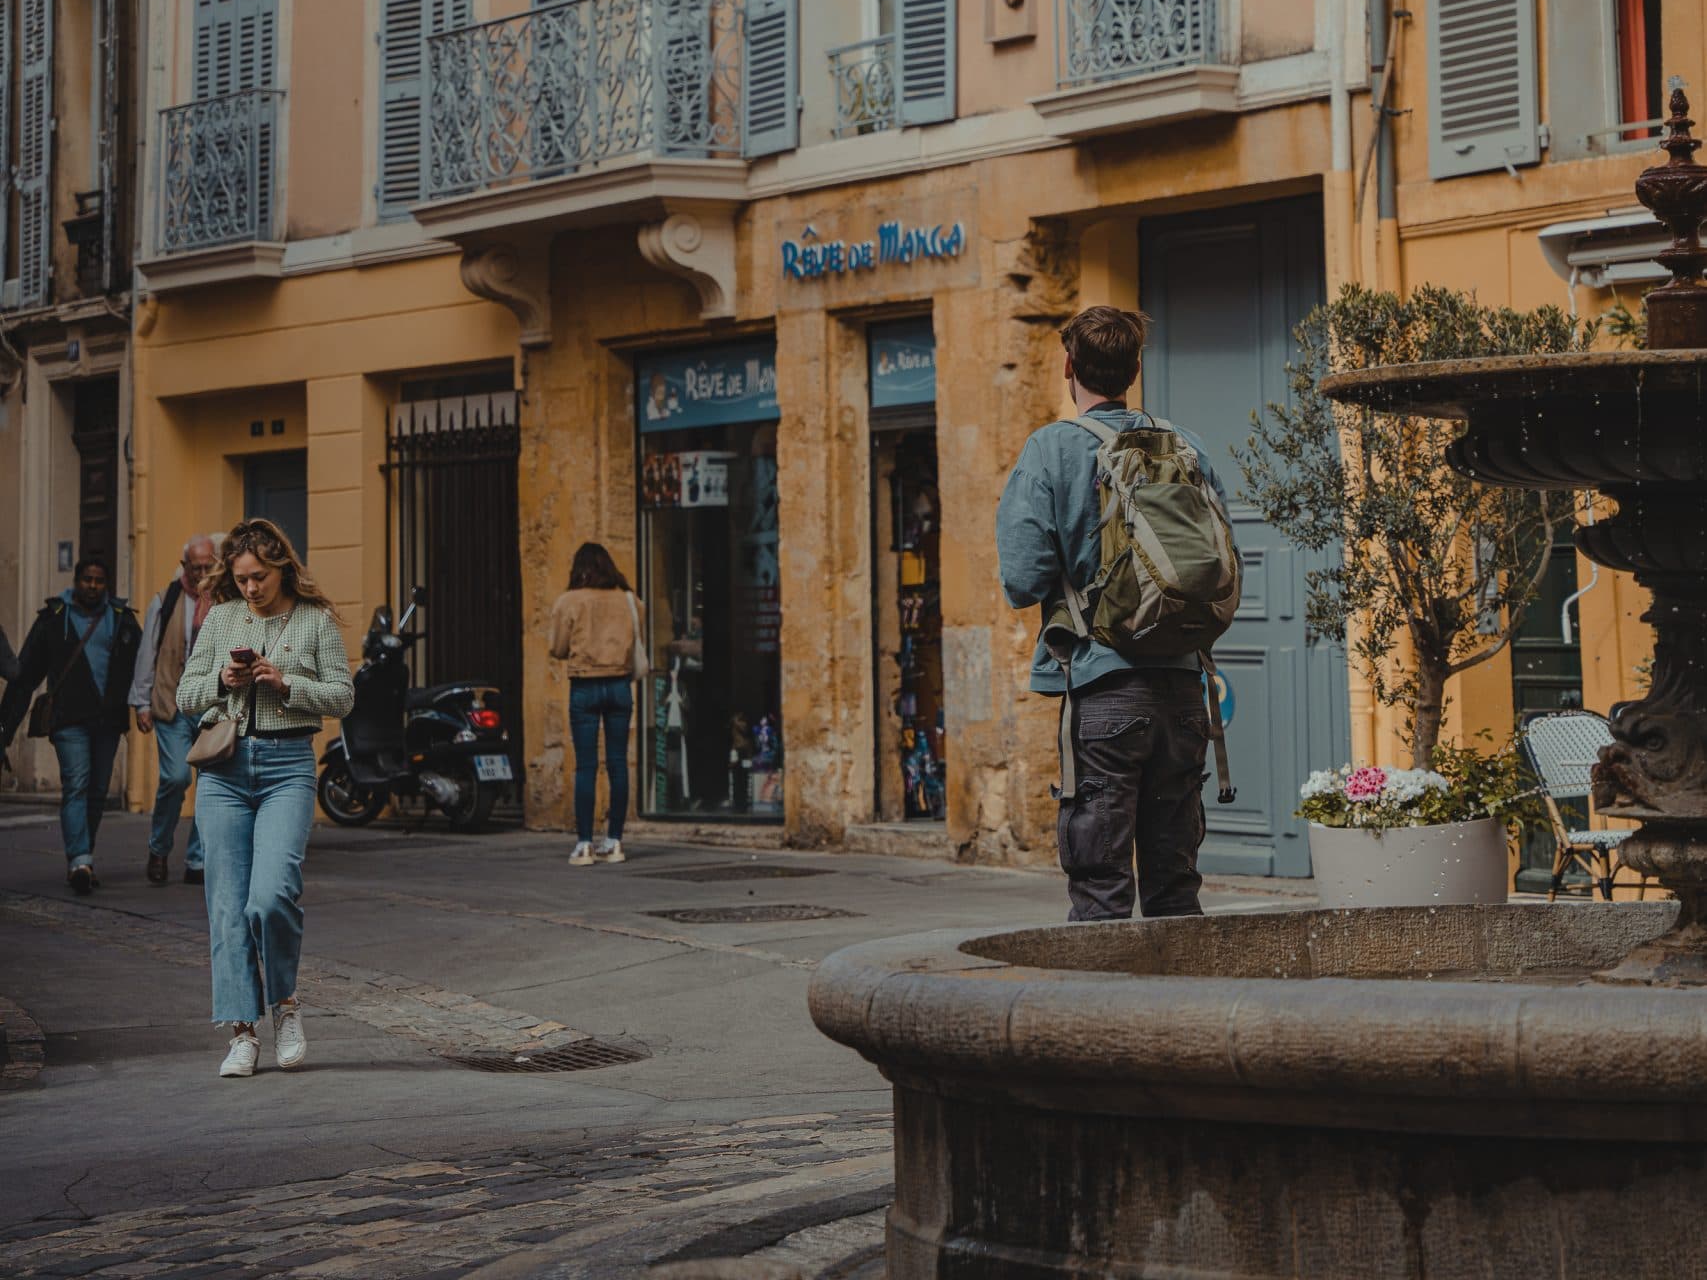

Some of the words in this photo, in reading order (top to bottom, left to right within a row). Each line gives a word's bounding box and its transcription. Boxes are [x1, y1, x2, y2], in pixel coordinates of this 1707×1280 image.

[848, 240, 874, 270] DE
[878, 219, 966, 264] MANGA
[745, 359, 776, 393] MAN
